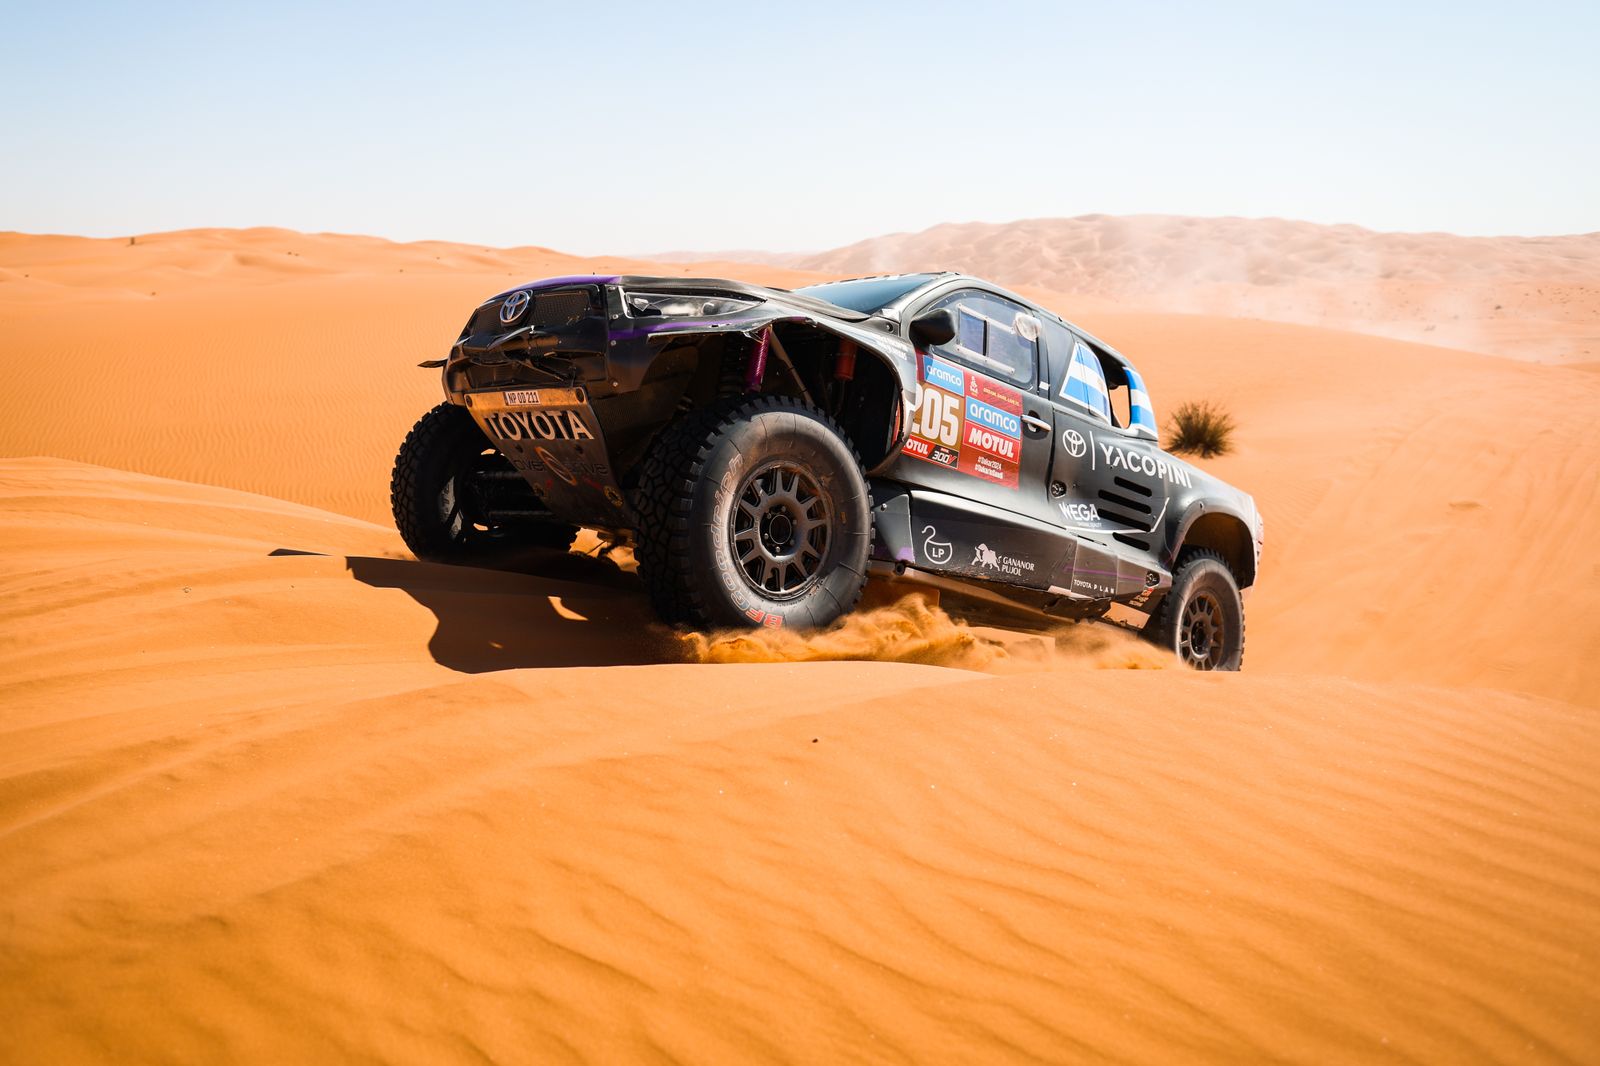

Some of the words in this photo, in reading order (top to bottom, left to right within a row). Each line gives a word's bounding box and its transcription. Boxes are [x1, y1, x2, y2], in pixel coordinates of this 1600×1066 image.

[926, 364, 962, 387] aramco
[526, 391, 539, 404] 211
[482, 410, 594, 440] TOYOTA
[969, 403, 1018, 433] aramco
[904, 438, 929, 455] OTUL
[968, 427, 1014, 458] MOTUL
[932, 450, 957, 465] 300V
[1099, 442, 1192, 489] YACOPINI
[1058, 501, 1101, 521] WEGA
[710, 452, 784, 630] BFGoodrich
[932, 547, 945, 559] LP
[1001, 564, 1022, 577] PUJOL
[1002, 556, 1035, 571] GANANOR
[1073, 579, 1092, 589] TOYOTA
